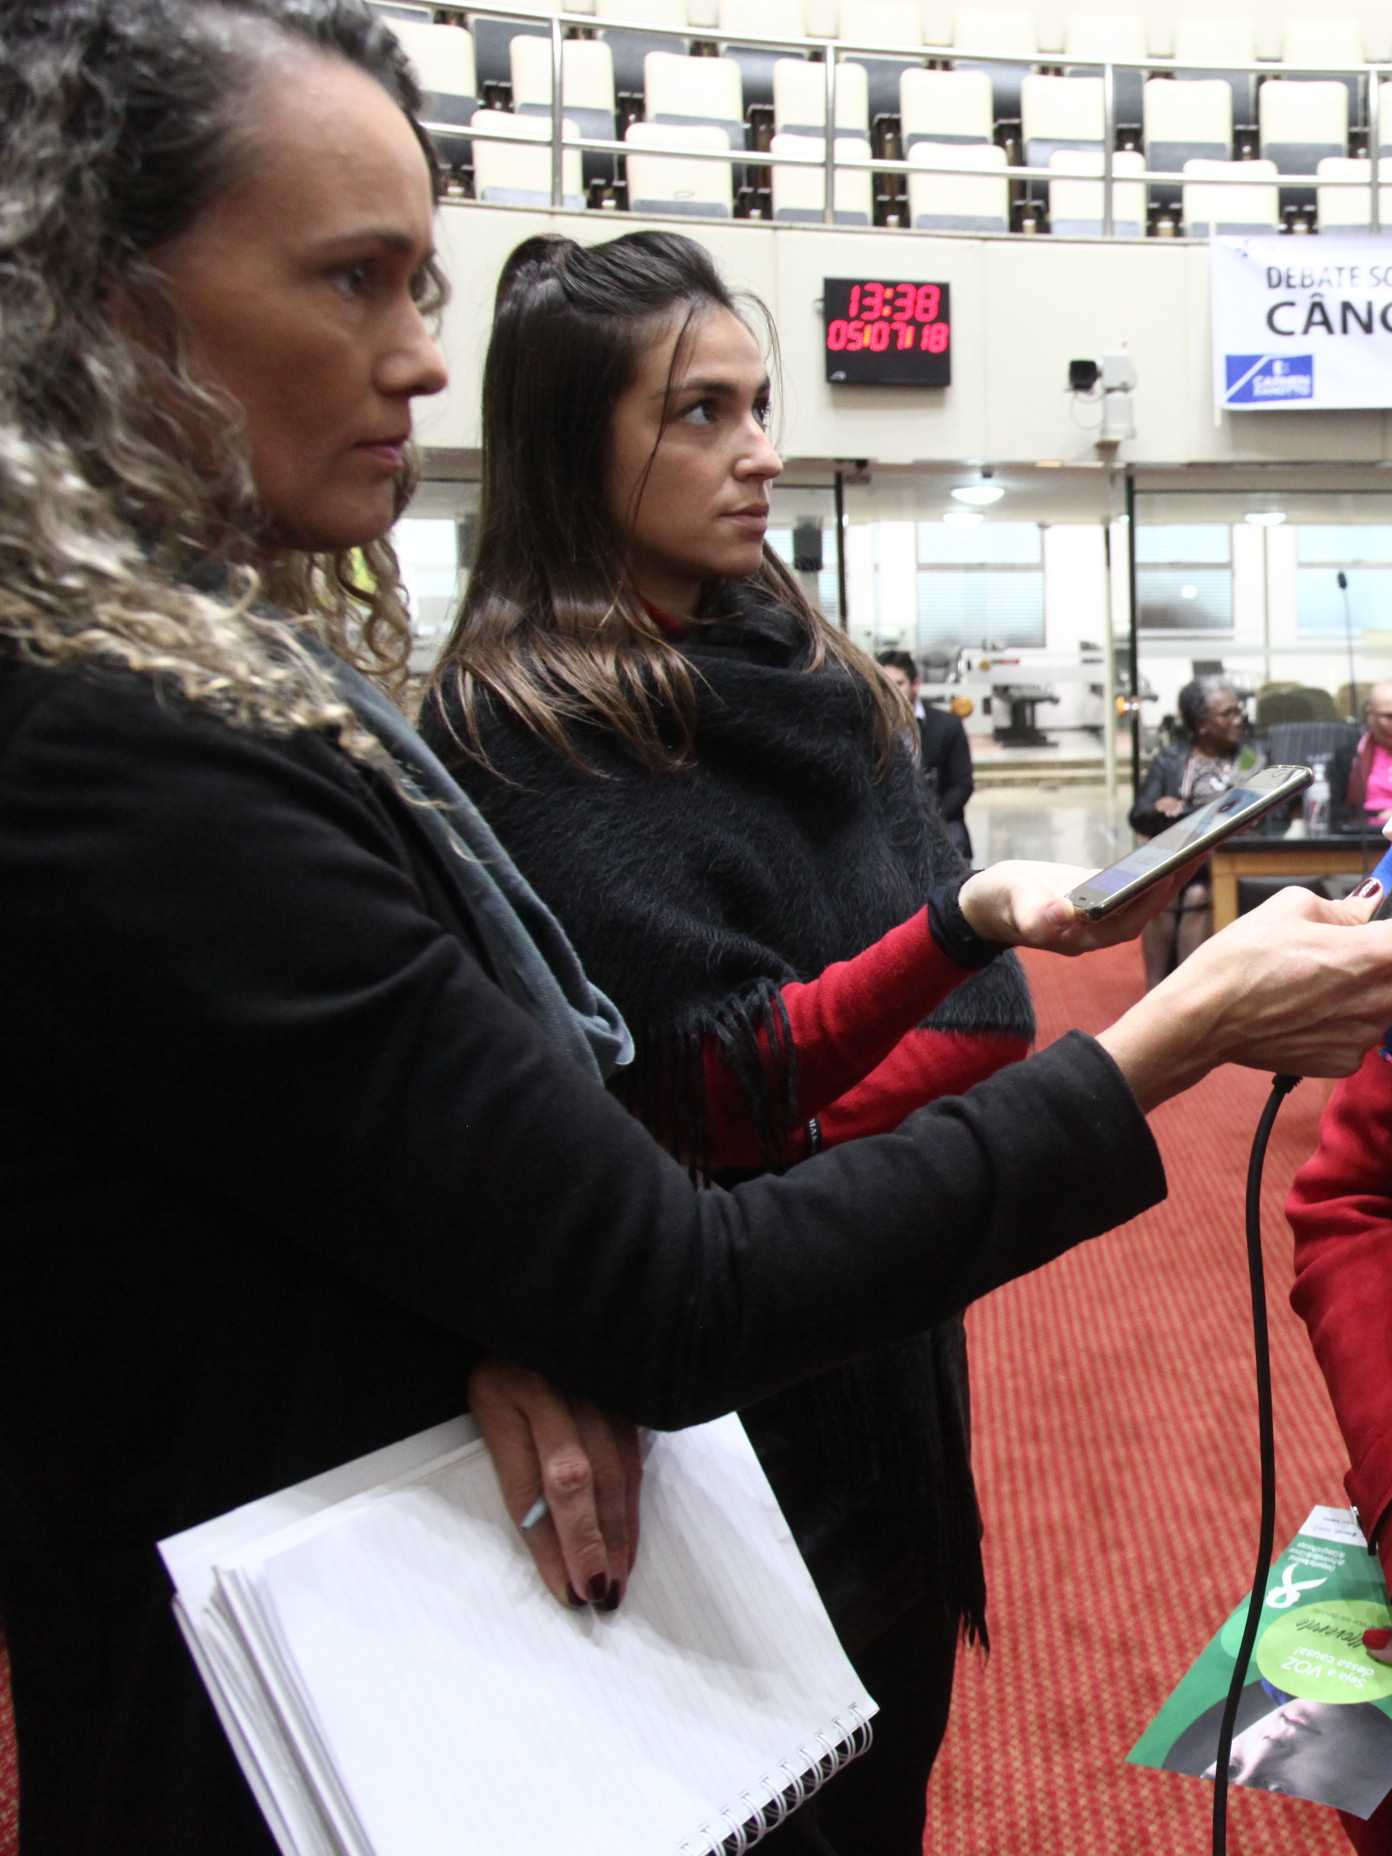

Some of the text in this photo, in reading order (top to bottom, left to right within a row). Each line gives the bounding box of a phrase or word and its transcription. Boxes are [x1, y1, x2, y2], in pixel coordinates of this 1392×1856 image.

[1267, 266, 1360, 289] DEBATE
[849, 282, 940, 322] 13:38
[1281, 1656, 1323, 1678] VOZ
[1337, 1659, 1375, 1677] dessa
[1338, 1672, 1367, 1688] Seja
